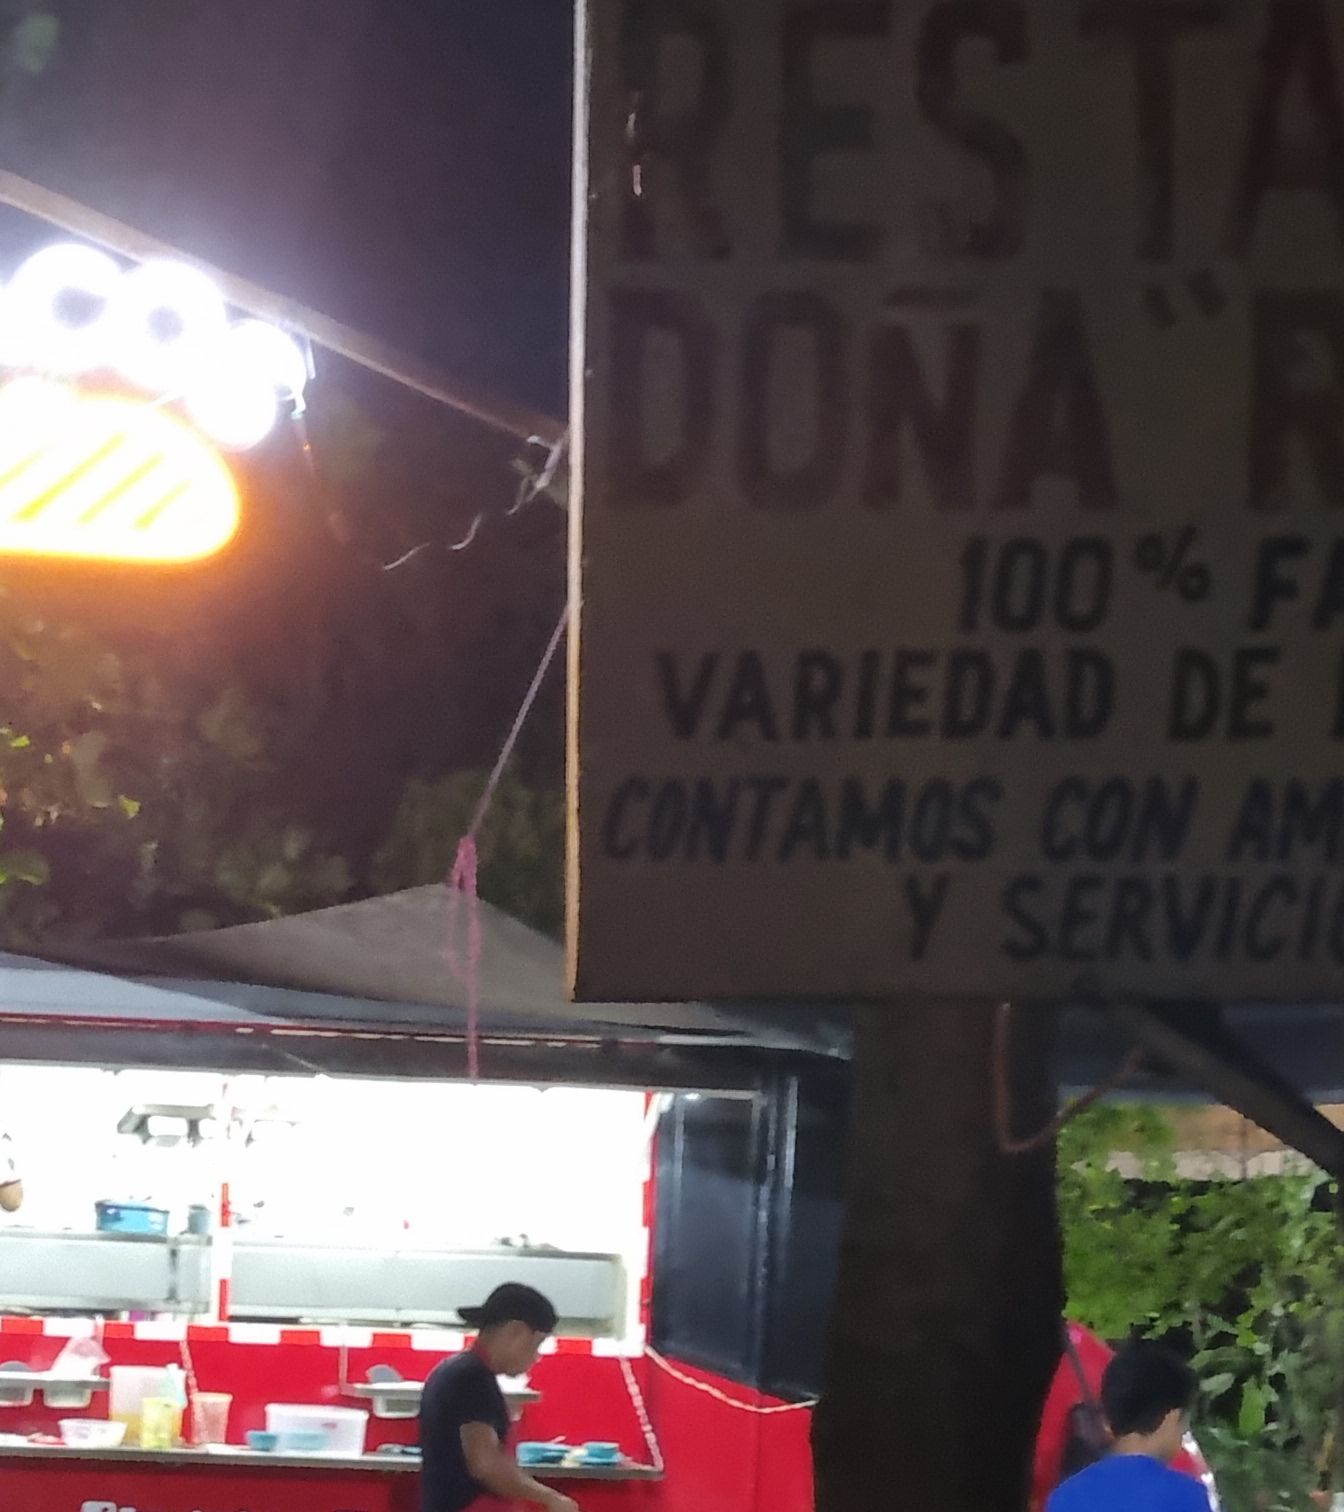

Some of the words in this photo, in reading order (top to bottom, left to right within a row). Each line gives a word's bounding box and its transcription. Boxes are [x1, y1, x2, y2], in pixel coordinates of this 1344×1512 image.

[617, 0, 1344, 263] RESTA
[602, 284, 1120, 513] DOÑA
[654, 648, 1115, 744] VARIEDAD
[1167, 645, 1280, 742] DE
[602, 775, 1004, 864] CONTAMOS
[1040, 775, 1199, 864] CON
[1226, 776, 1344, 864] AM
[903, 873, 949, 962] Y
